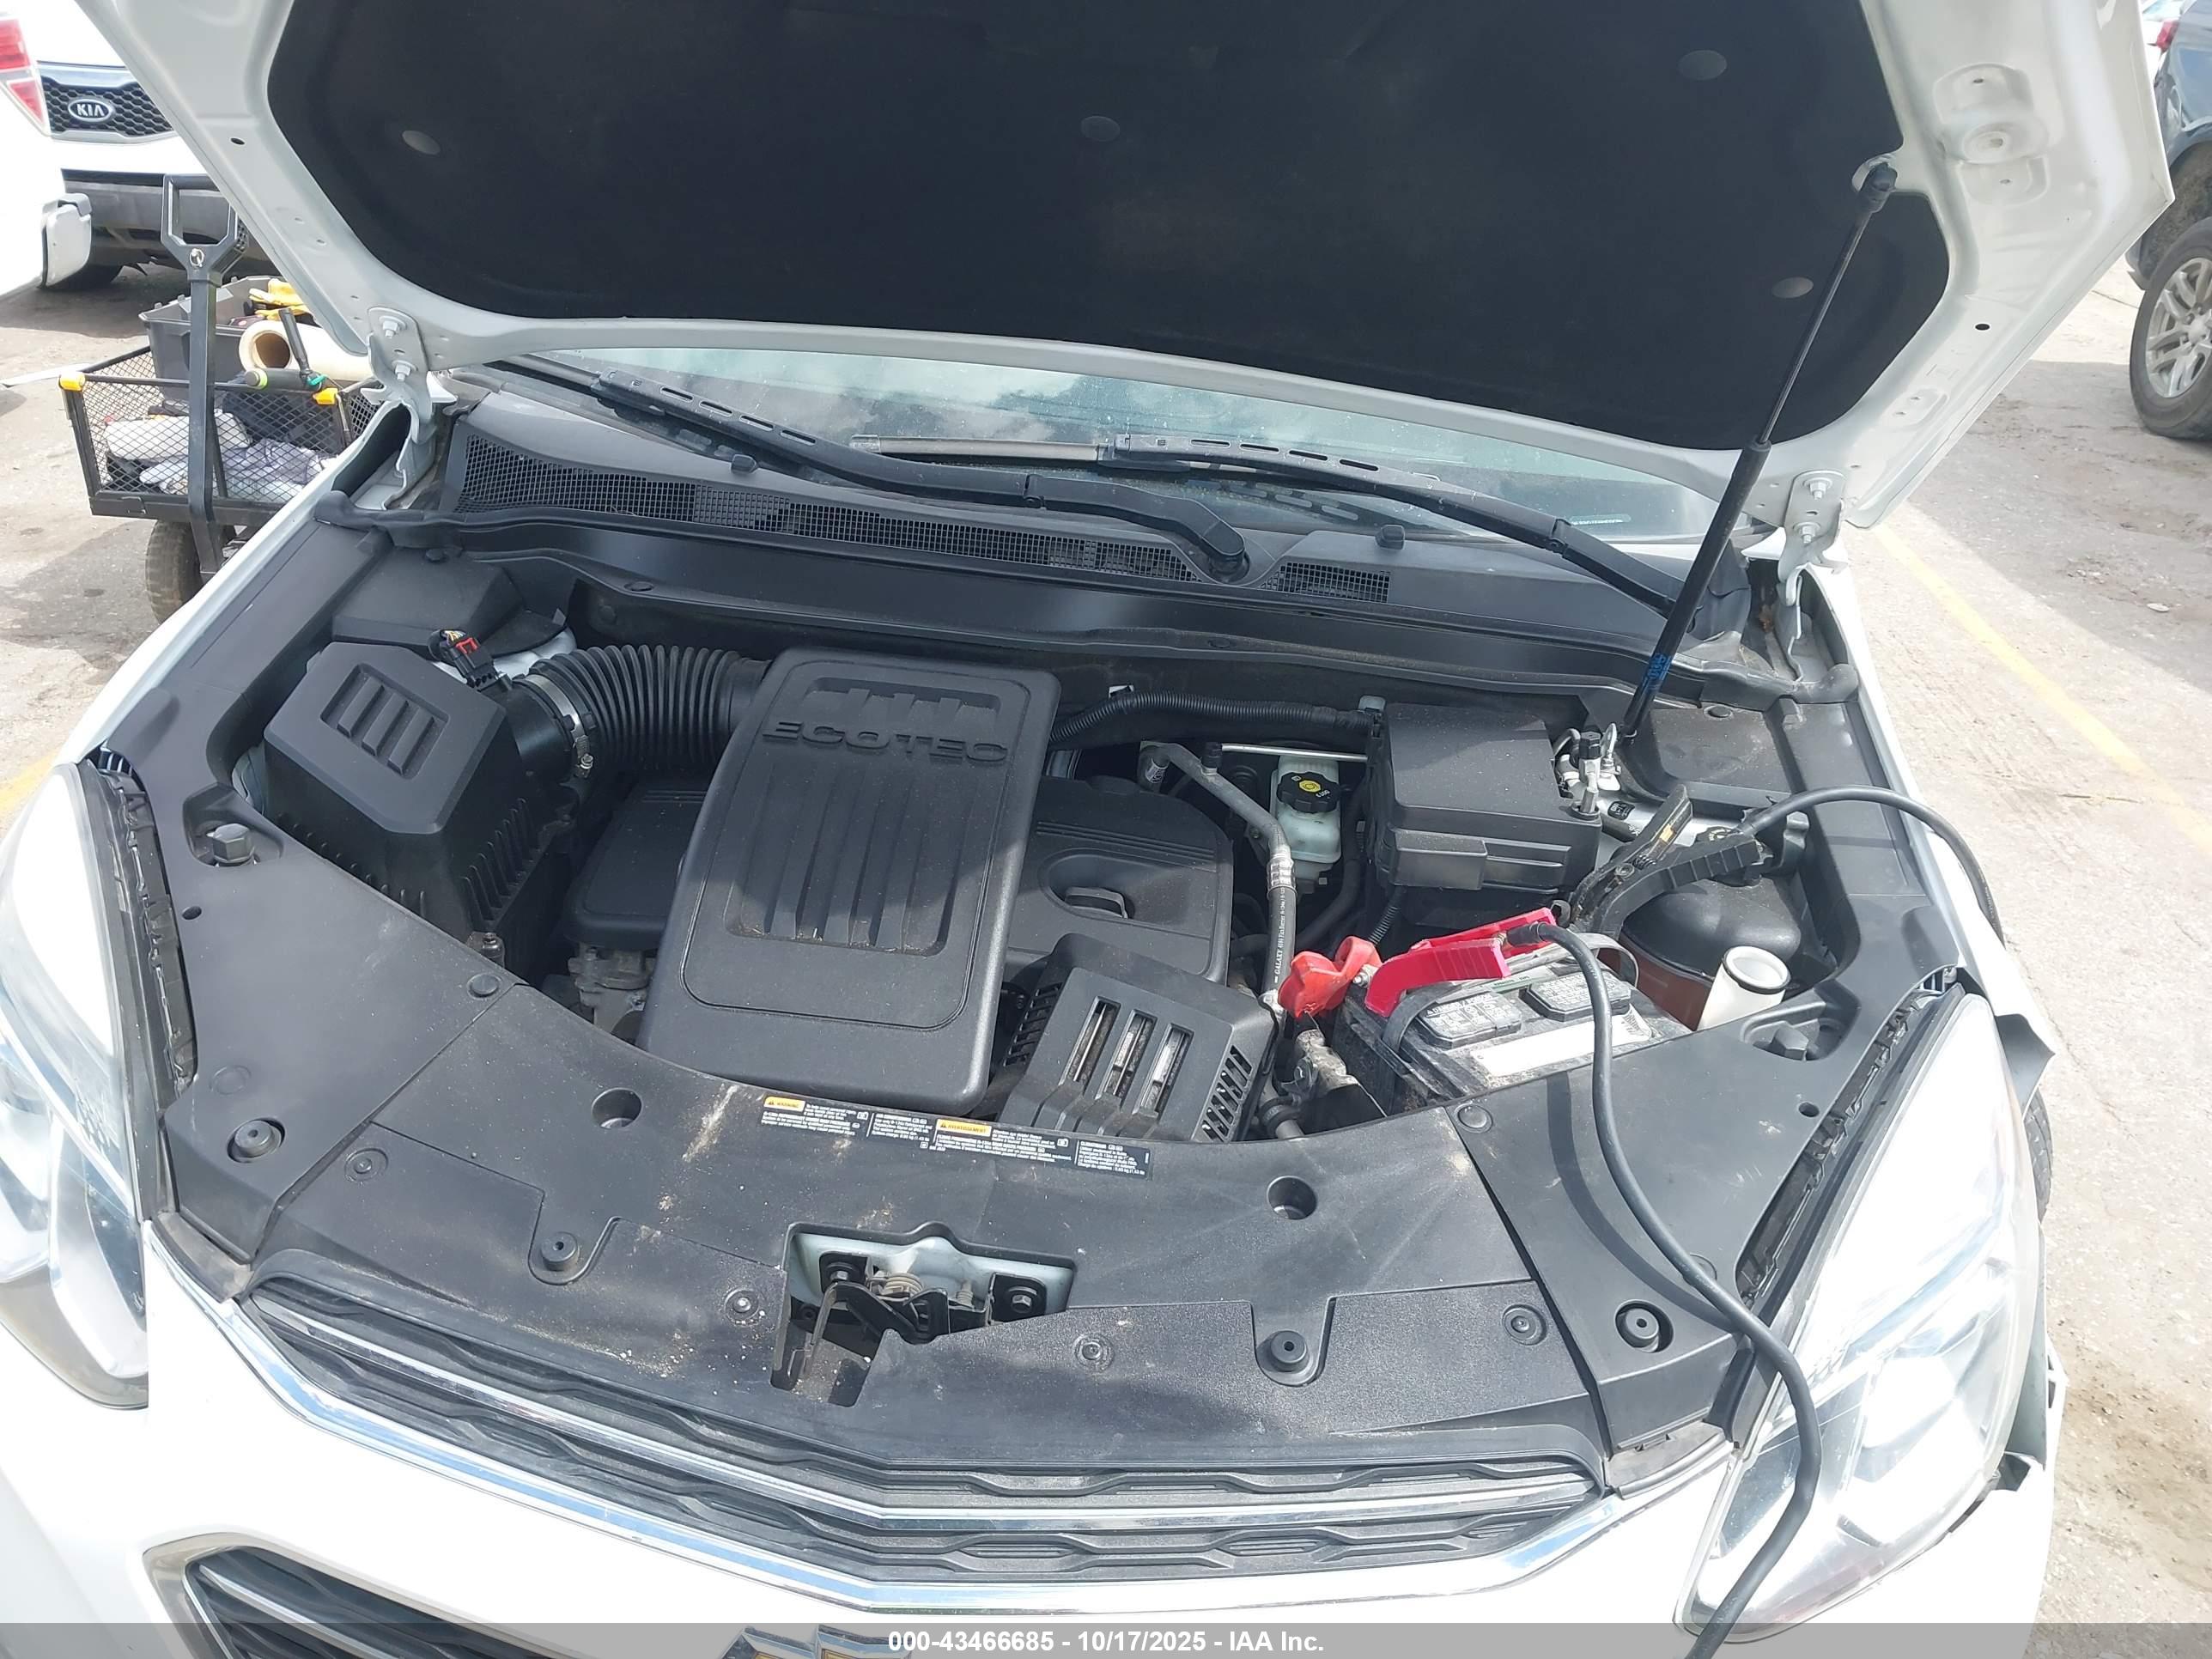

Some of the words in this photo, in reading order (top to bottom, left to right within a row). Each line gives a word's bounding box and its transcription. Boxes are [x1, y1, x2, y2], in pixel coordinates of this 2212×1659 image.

[76, 103, 105, 117] KIA
[762, 721, 1009, 763] ECOTEC
[1274, 948, 1283, 975] GALAXY
